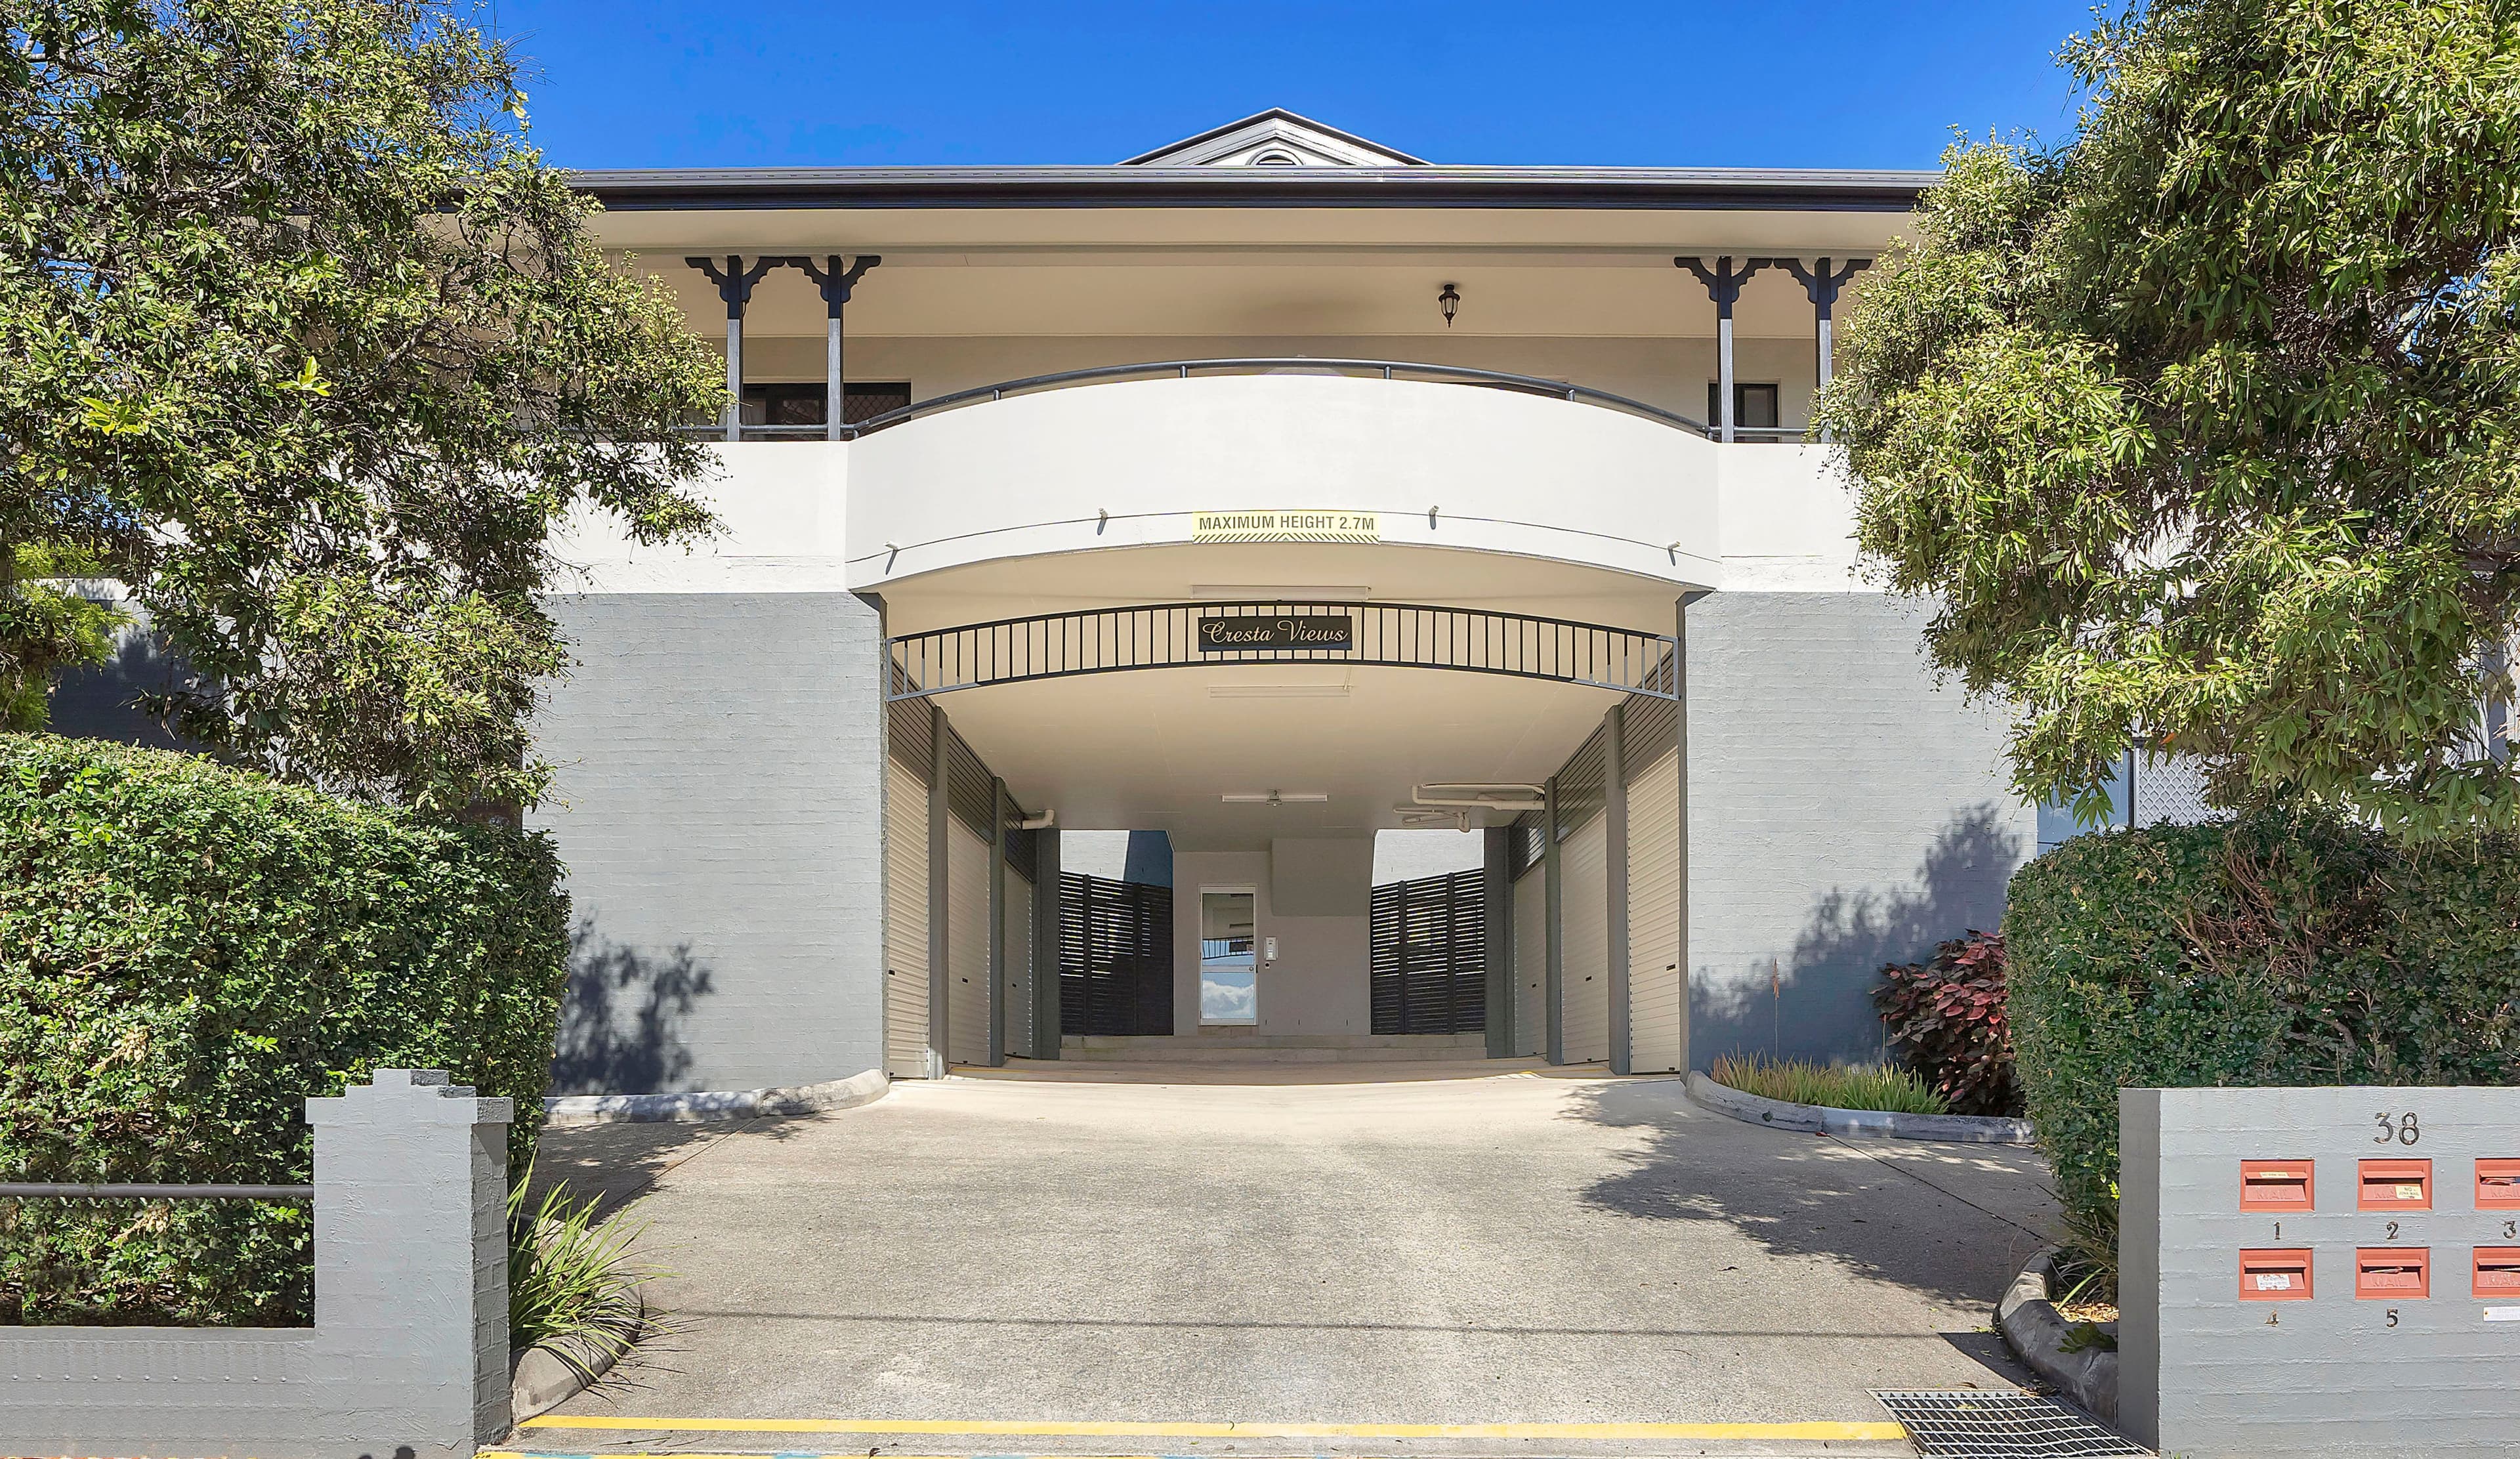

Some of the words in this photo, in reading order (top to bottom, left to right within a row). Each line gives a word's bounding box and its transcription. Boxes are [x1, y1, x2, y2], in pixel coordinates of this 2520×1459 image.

[1200, 516, 1274, 530] MAXIMUM
[1280, 516, 1334, 528] HEIGHT
[1339, 517, 1375, 530] 2.7M
[1202, 621, 1275, 643] Cresta
[1276, 619, 1349, 642] Views
[2373, 1112, 2420, 1145] 38
[2256, 1186, 2293, 1200] MAIL
[2373, 1185, 2395, 1199] MA
[2490, 1186, 2520, 1198] MAI
[2274, 1221, 2280, 1240] 1
[2387, 1221, 2399, 1240] 2
[2503, 1221, 2517, 1239] 3
[2370, 1275, 2408, 1287] MAIL
[2264, 1309, 2279, 1327] 4
[2386, 1309, 2399, 1328] 5
